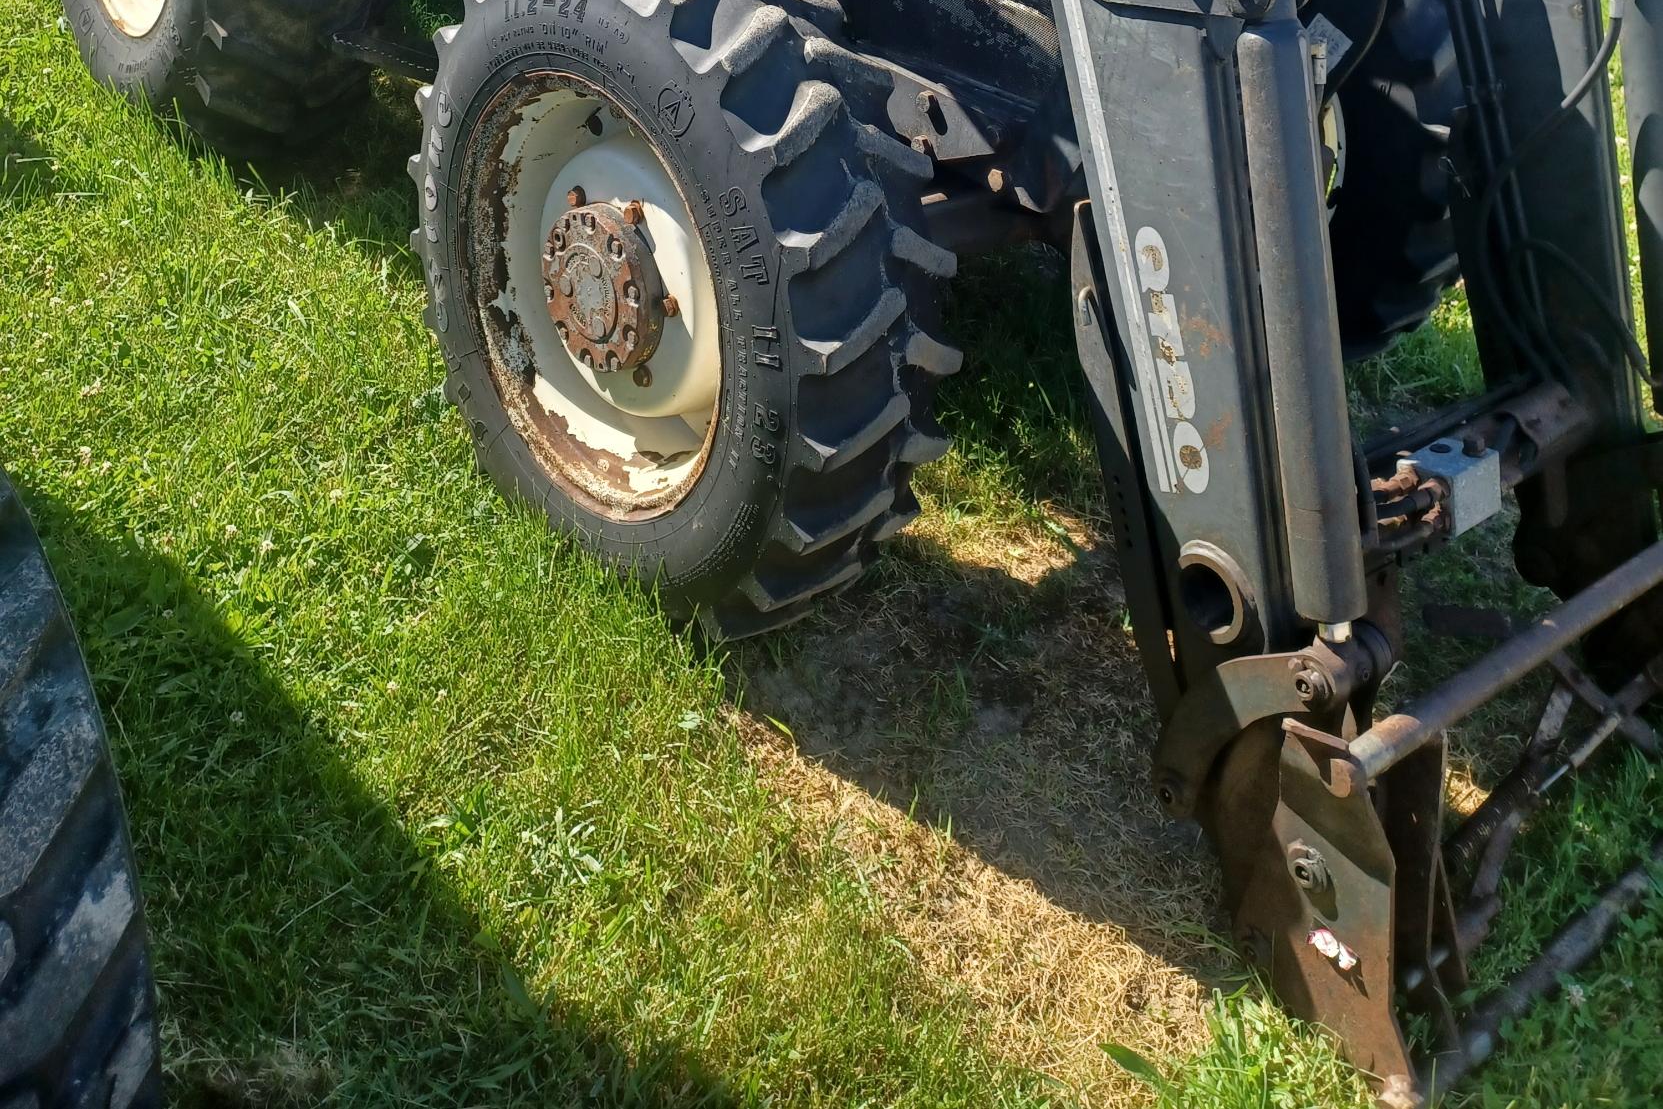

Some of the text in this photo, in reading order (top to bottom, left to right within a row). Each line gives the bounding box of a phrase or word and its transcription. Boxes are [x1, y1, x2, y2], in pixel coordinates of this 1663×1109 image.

[424, 89, 489, 450] Firestone
[701, 190, 731, 267] SUPER
[719, 186, 770, 286] SAT
[726, 278, 743, 321] ALL
[734, 334, 749, 444] TRACTION
